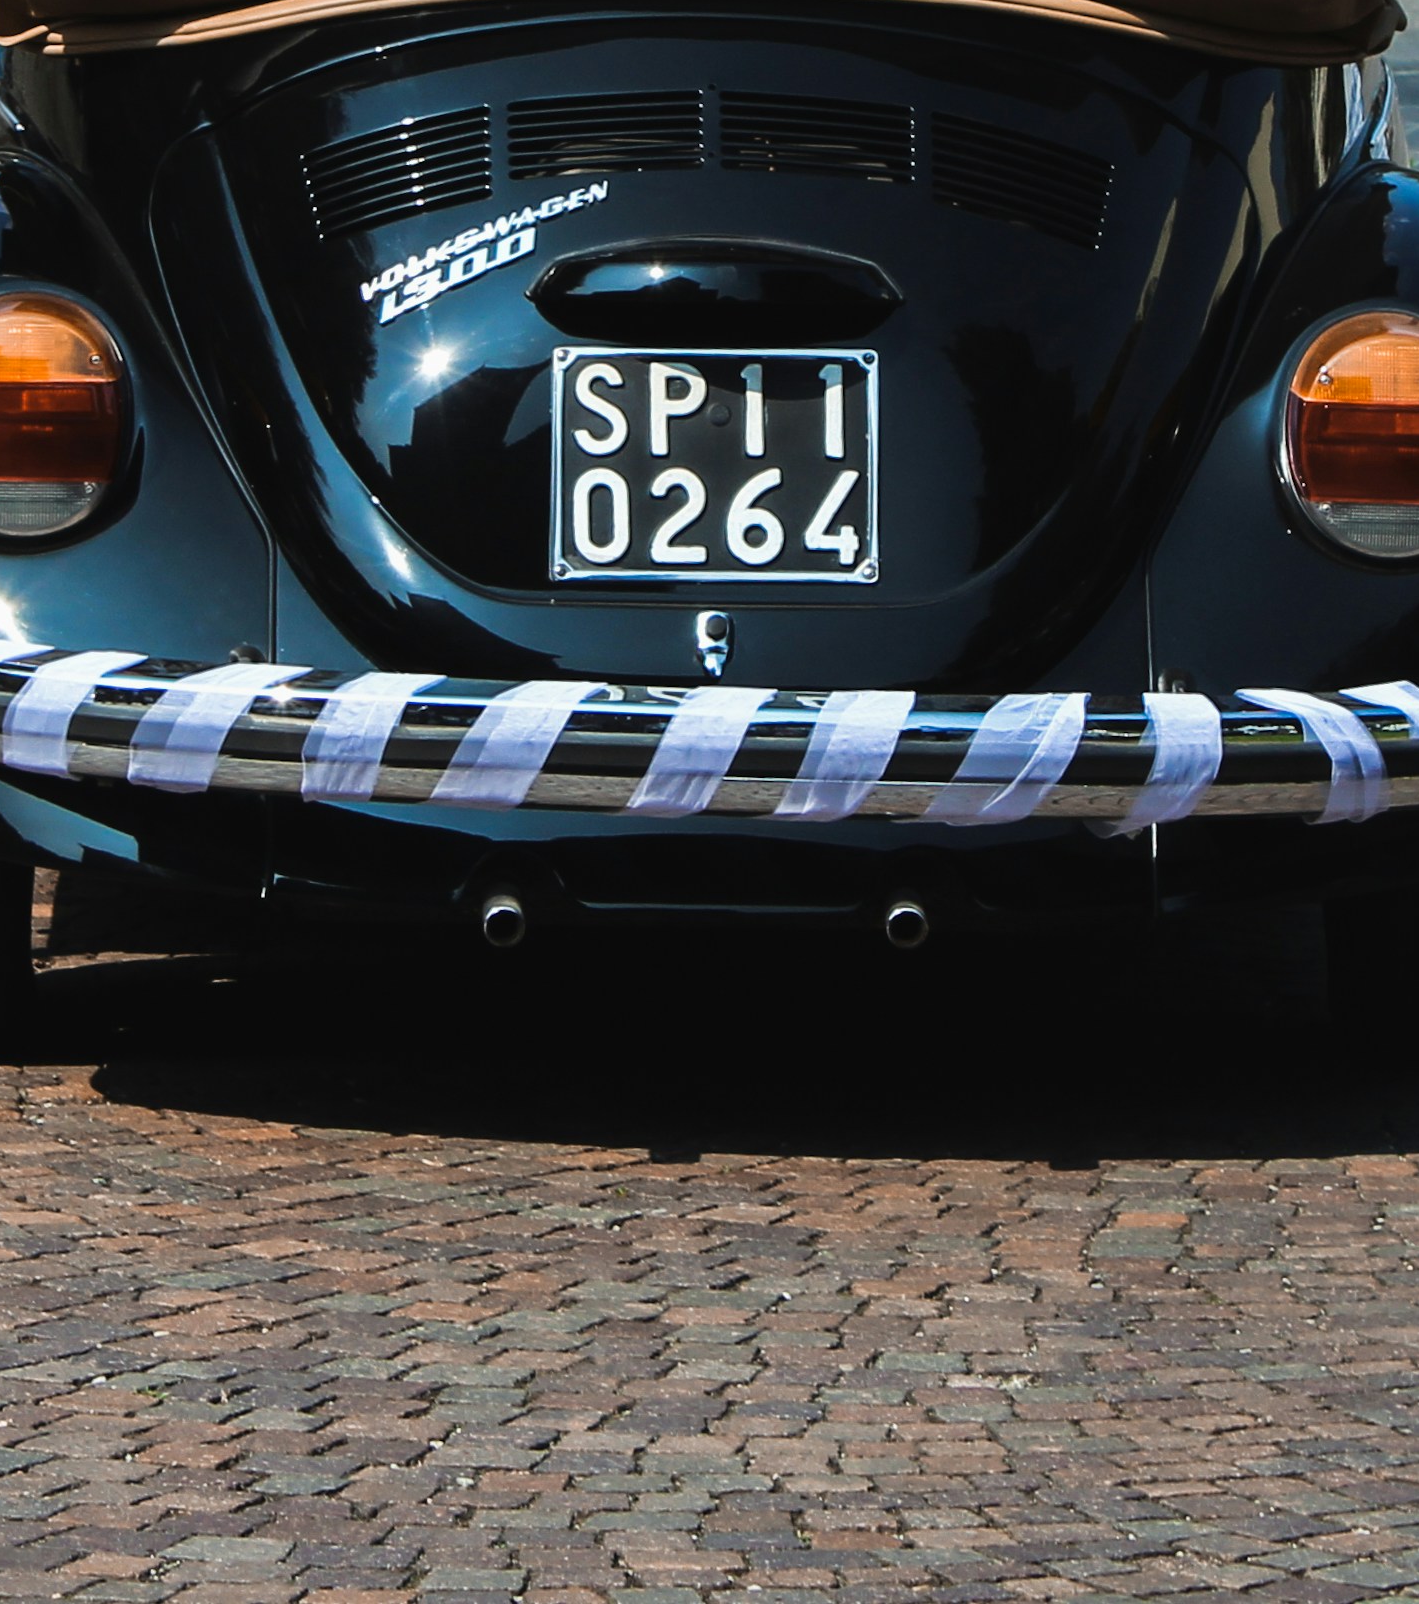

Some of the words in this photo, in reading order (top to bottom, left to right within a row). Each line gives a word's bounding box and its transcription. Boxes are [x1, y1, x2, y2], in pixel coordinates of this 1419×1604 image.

[360, 179, 610, 303] VOLKSWAGEN
[379, 226, 537, 325] 1300
[571, 361, 846, 460] SP11
[571, 466, 860, 567] 0264
